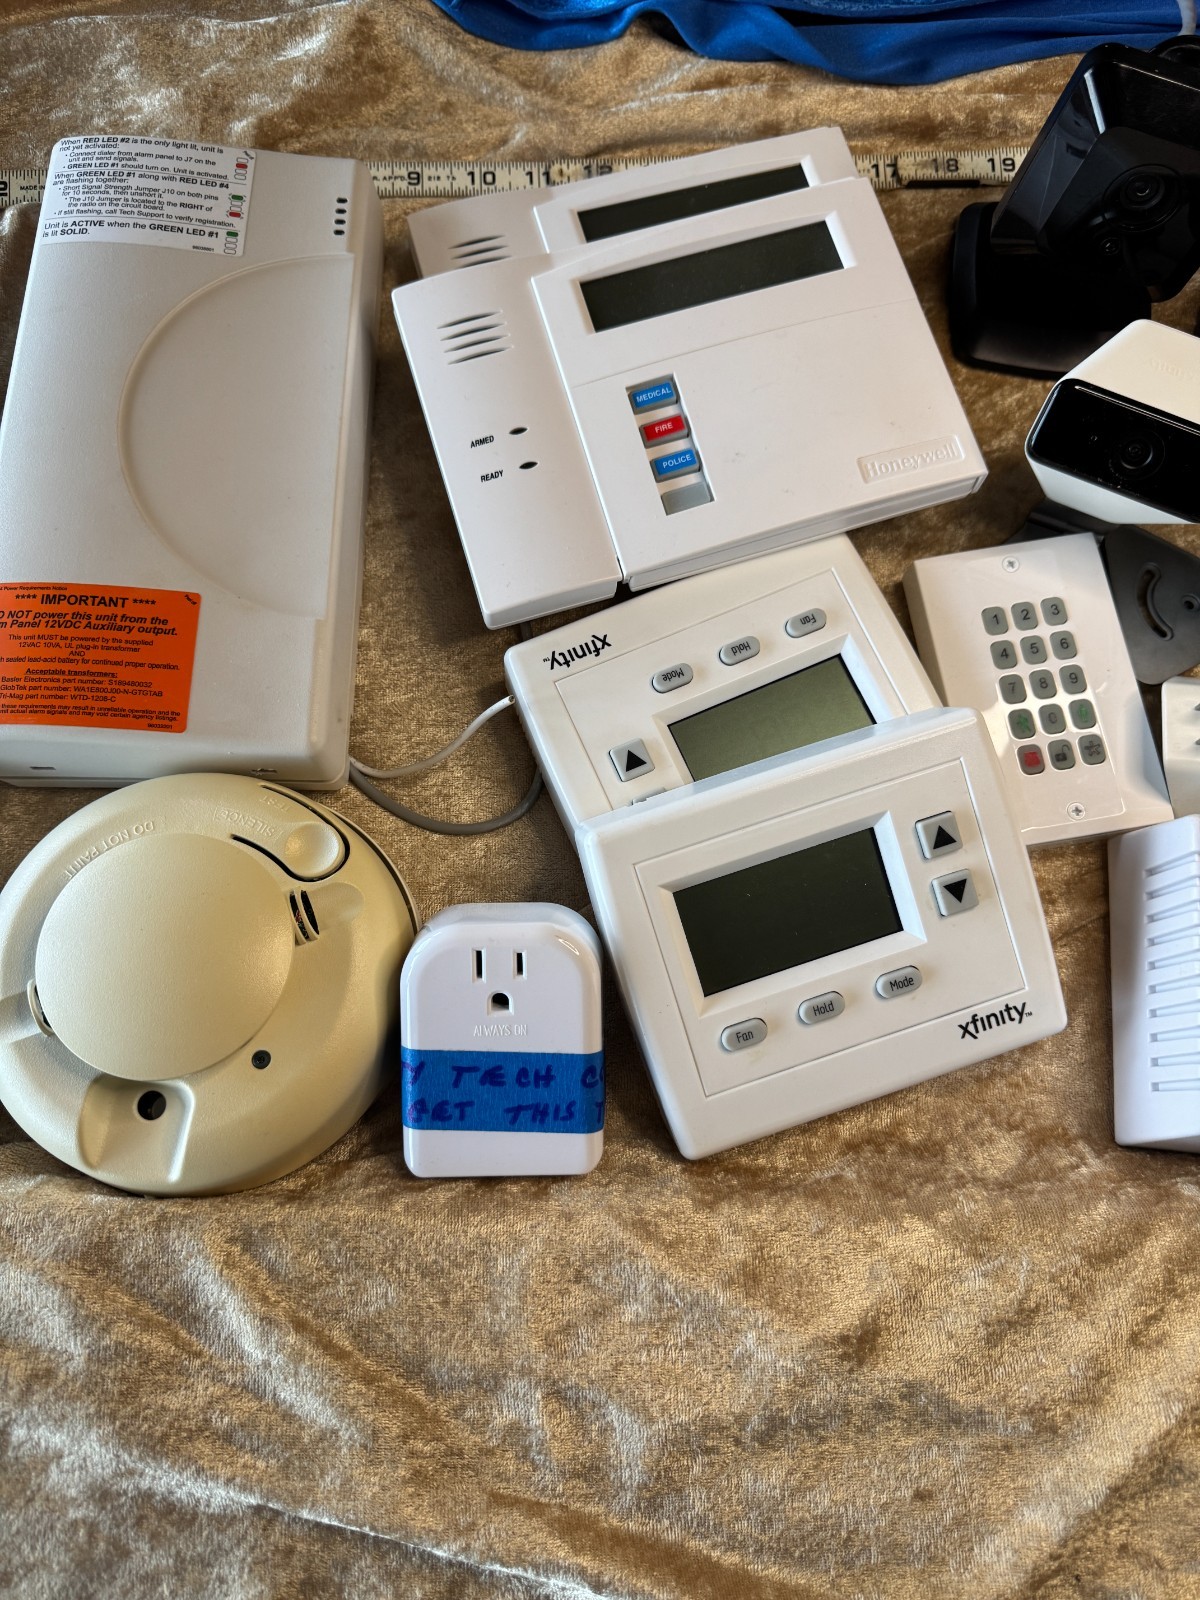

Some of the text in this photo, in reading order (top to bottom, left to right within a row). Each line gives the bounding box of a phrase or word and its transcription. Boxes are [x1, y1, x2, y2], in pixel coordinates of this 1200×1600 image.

[154, 140, 170, 148] only
[172, 141, 188, 149] light
[190, 143, 199, 151] lit,
[871, 162, 898, 178] 17
[932, 158, 959, 173] 18
[987, 157, 1016, 173] 19
[138, 173, 159, 181] along
[179, 177, 197, 185] RED
[200, 180, 217, 188] LED
[173, 167, 187, 175] Unit
[196, 171, 229, 180] activated.
[408, 171, 420, 186] 9
[467, 171, 496, 186] 10
[65, 177, 95, 185] flashing
[137, 210, 164, 219] Support
[175, 215, 193, 223] verify
[195, 217, 236, 228] registration.
[44, 222, 60, 230] Unit
[149, 223, 183, 233] GREEN
[186, 228, 206, 236] LED
[208, 231, 219, 239] #1
[636, 387, 671, 403] MEDICAL
[655, 422, 673, 433] FIRE
[470, 435, 495, 449] ARMED
[662, 454, 692, 469] POLICE
[865, 442, 958, 478] Honeywell
[480, 470, 504, 483] READY
[41, 594, 128, 608] IMPORTANT
[1021, 609, 1031, 621] 2
[1051, 604, 1060, 616] 3
[7, 610, 33, 619] NOT
[33, 611, 69, 620] power
[71, 611, 92, 620] this
[95, 613, 118, 622] unit
[120, 614, 148, 624] from
[150, 616, 169, 625] the
[800, 613, 817, 626] Fan
[992, 614, 999, 625] 1
[10, 620, 41, 628] Panel
[44, 620, 82, 629] 12VDC
[83, 621, 135, 634] Auxiliary
[137, 625, 177, 636] output.
[76, 643, 99, 651] plug-in
[101, 644, 141, 653] transformer
[124, 639, 154, 647] supplied
[731, 641, 750, 656] Hold
[1030, 642, 1039, 655] 5
[1060, 637, 1069, 649] 6
[1000, 647, 1009, 659] 4
[57, 657, 79, 665] battery
[81, 657, 90, 665] for
[91, 659, 124, 667] continued
[68, 670, 118, 678] transformers:
[662, 667, 685, 682] Mode
[1069, 672, 1078, 684] 9
[1008, 682, 1016, 694] 7
[1039, 677, 1049, 689] 8
[133, 821, 155, 836] DO
[99, 829, 130, 851] NOT
[889, 975, 915, 992] Mode
[813, 1001, 834, 1017] Hold
[473, 1024, 527, 1037] ALWAYS ON
[736, 1029, 754, 1044] Fan
[451, 1064, 556, 1089] TECH
[504, 1101, 576, 1126] THIS
